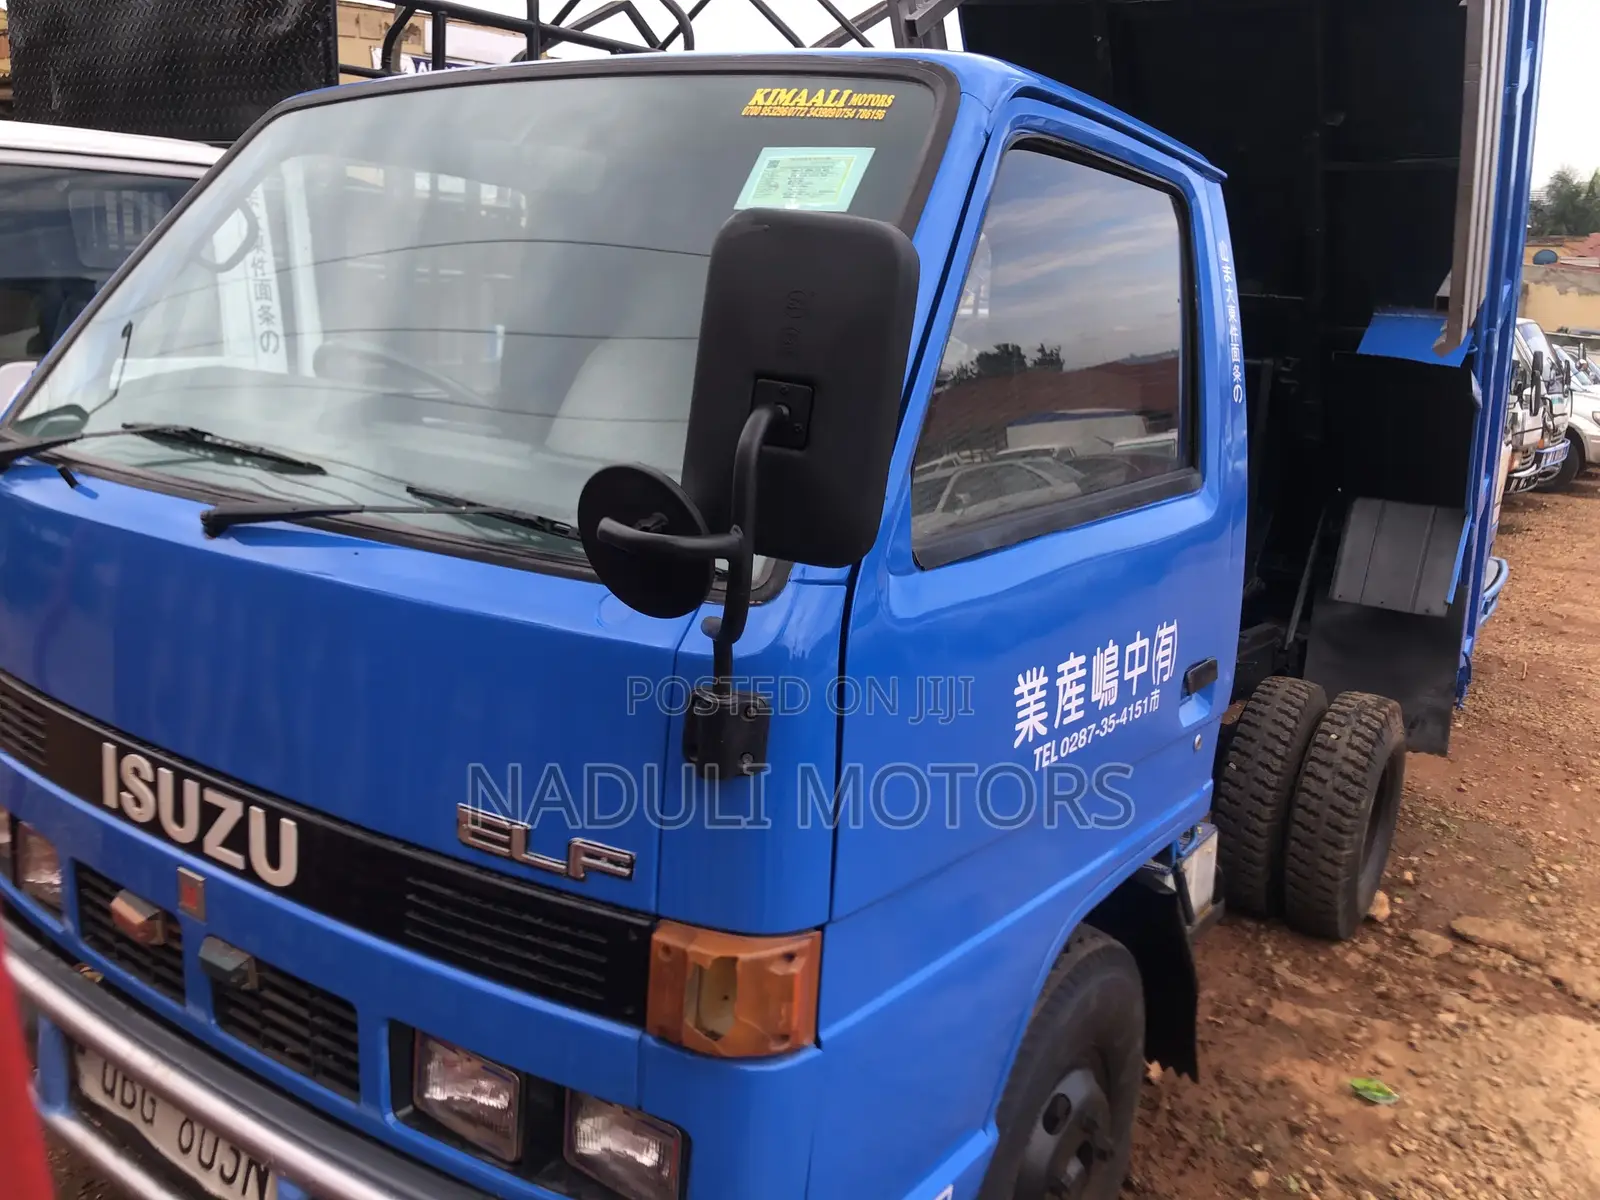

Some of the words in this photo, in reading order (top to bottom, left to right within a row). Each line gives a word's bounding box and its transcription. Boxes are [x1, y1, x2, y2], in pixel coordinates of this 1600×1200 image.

[748, 88, 852, 107] KIMAALI
[848, 93, 895, 107] MOTORS
[1033, 740, 1058, 772] TEL
[102, 742, 298, 887] ISUZU
[457, 803, 636, 881] ELF
